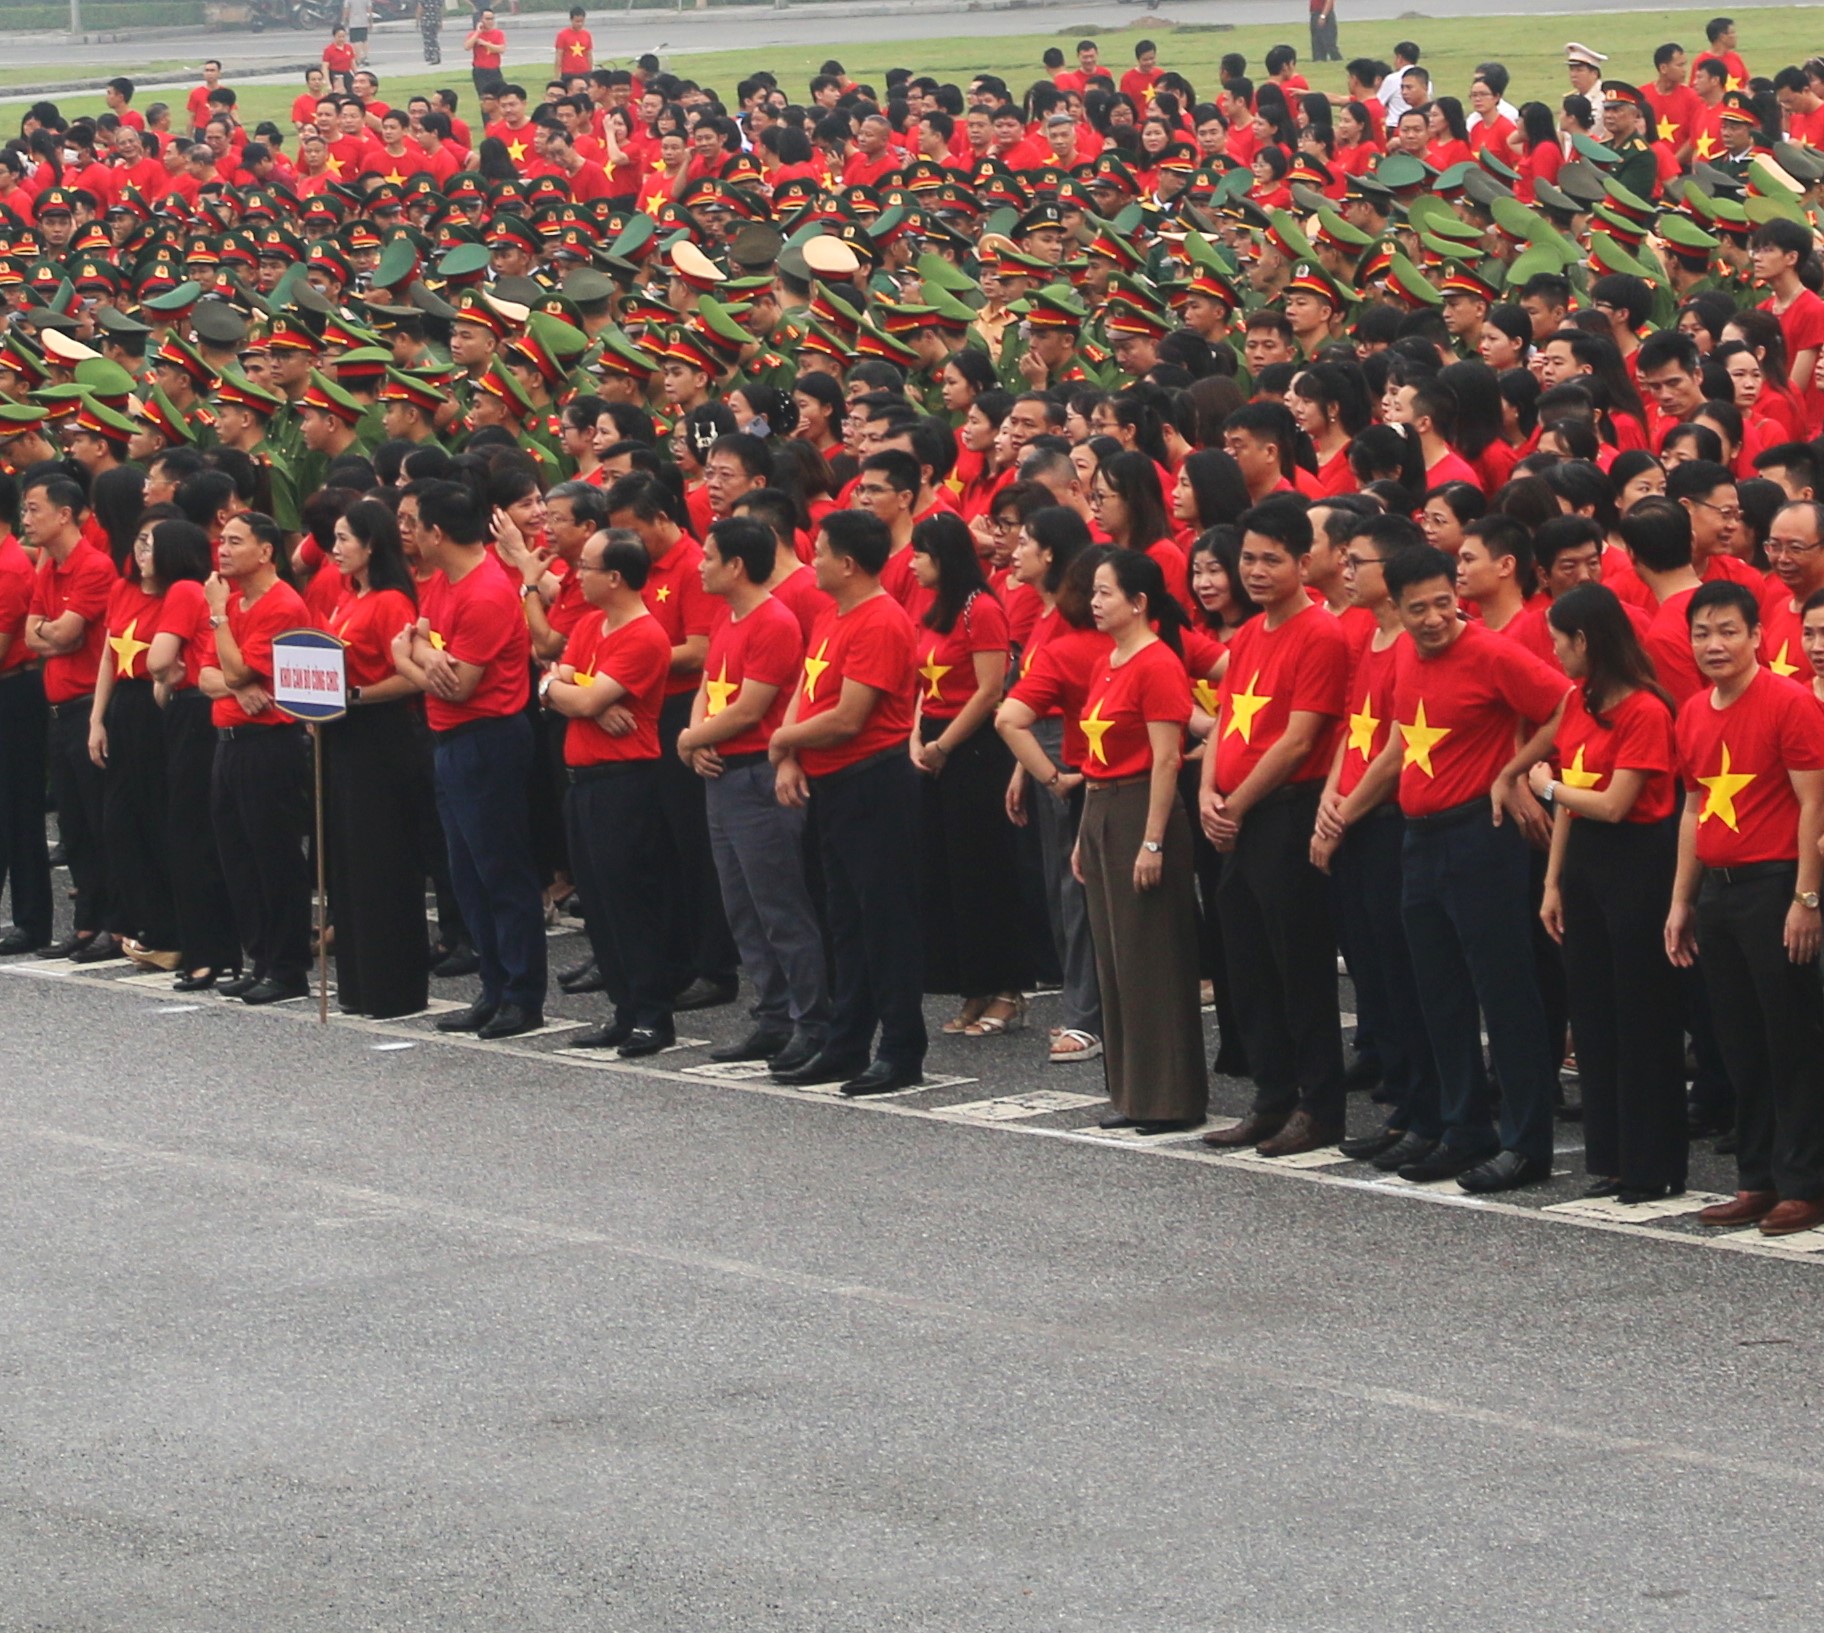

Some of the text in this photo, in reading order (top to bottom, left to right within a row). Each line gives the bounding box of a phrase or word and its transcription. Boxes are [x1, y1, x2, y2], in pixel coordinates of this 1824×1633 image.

[280, 659, 339, 695] KHỐI CÁN BỘ CÔNG CHỨC
